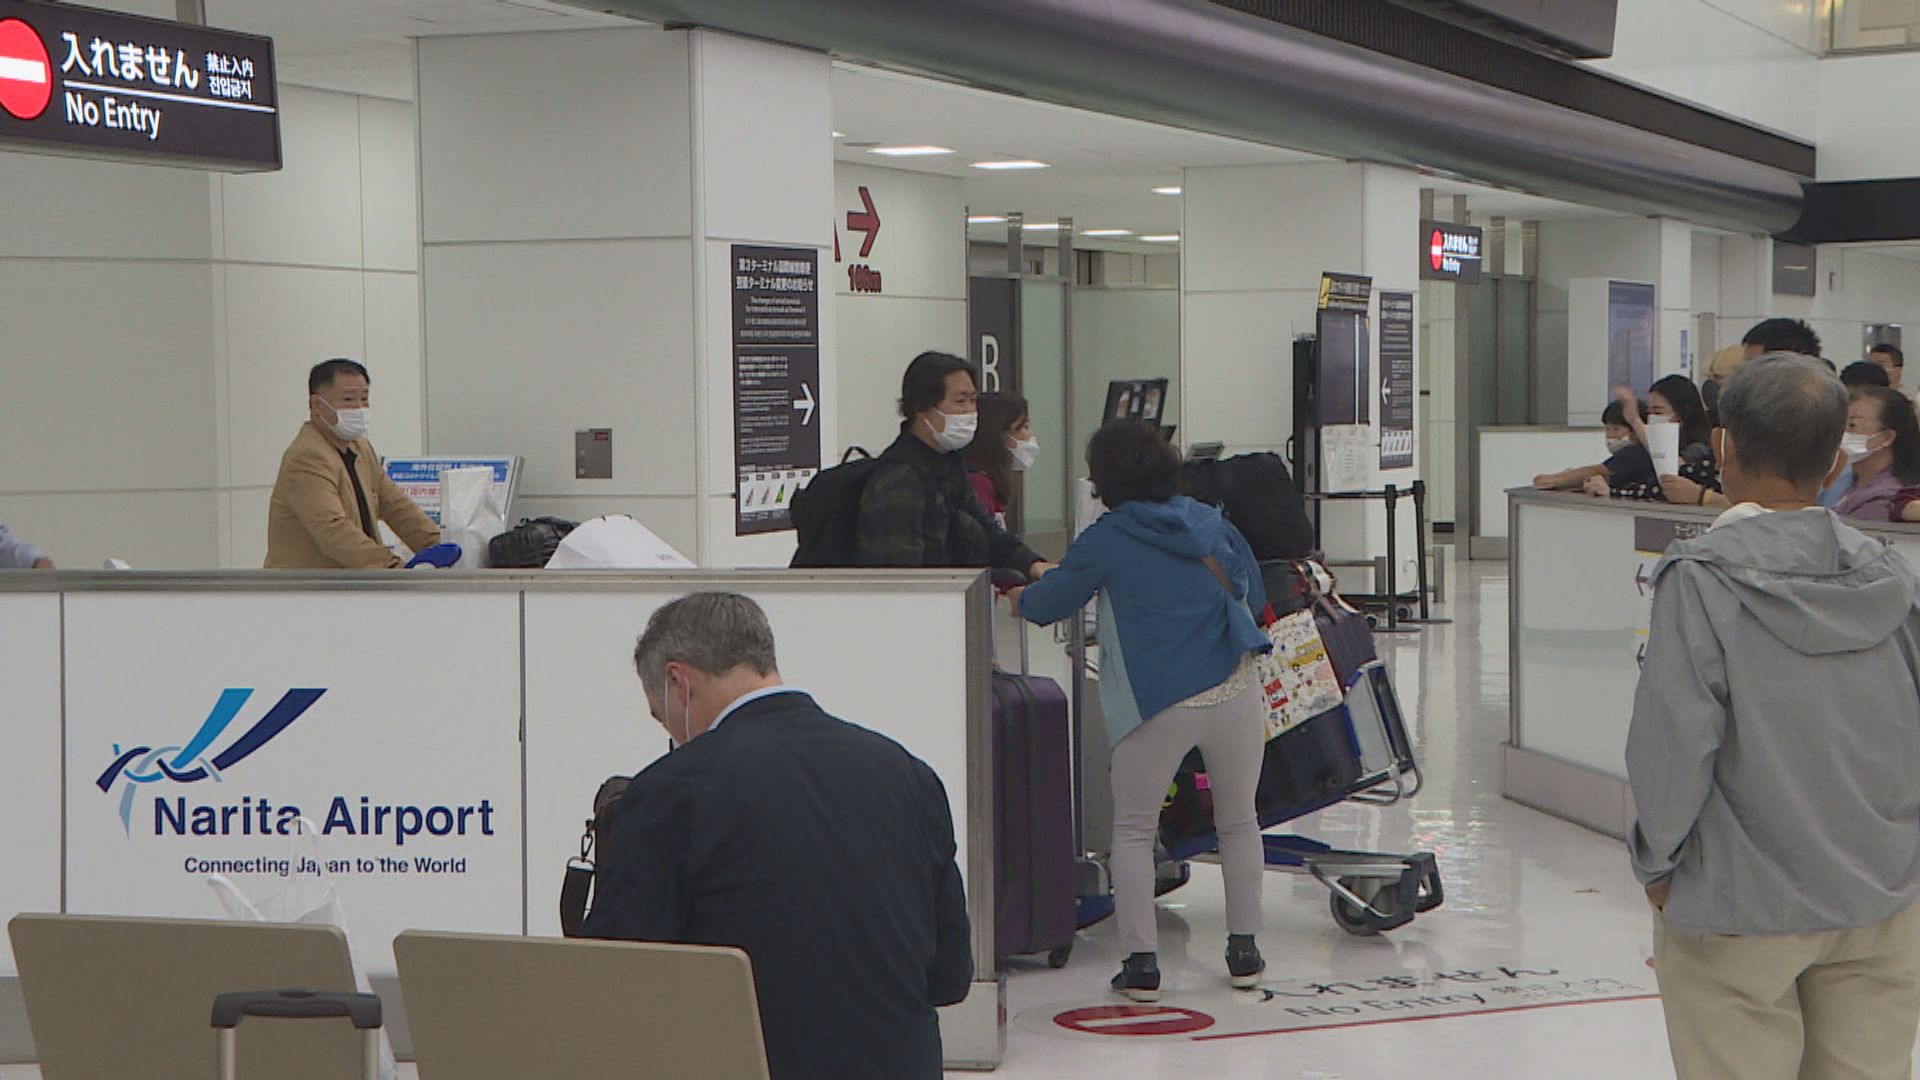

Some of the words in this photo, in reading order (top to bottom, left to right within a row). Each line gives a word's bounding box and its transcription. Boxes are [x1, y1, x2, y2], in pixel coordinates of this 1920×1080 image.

[61, 31, 199, 89] 入れません
[205, 51, 254, 78] 禁止入内
[209, 76, 252, 100] 진입금지
[64, 92, 99, 125] No
[104, 96, 161, 140] Entry
[848, 264, 882, 293] 100m
[982, 335, 1000, 392] R
[154, 796, 301, 836] Narita
[321, 796, 494, 845] Airport
[184, 856, 289, 877] Connecting
[357, 858, 373, 874] to
[380, 857, 409, 874] the
[415, 857, 466, 874] World
[1256, 966, 1559, 1002] 入れません
[1284, 1005, 1361, 1018] No
[1361, 992, 1487, 1012] Entry
